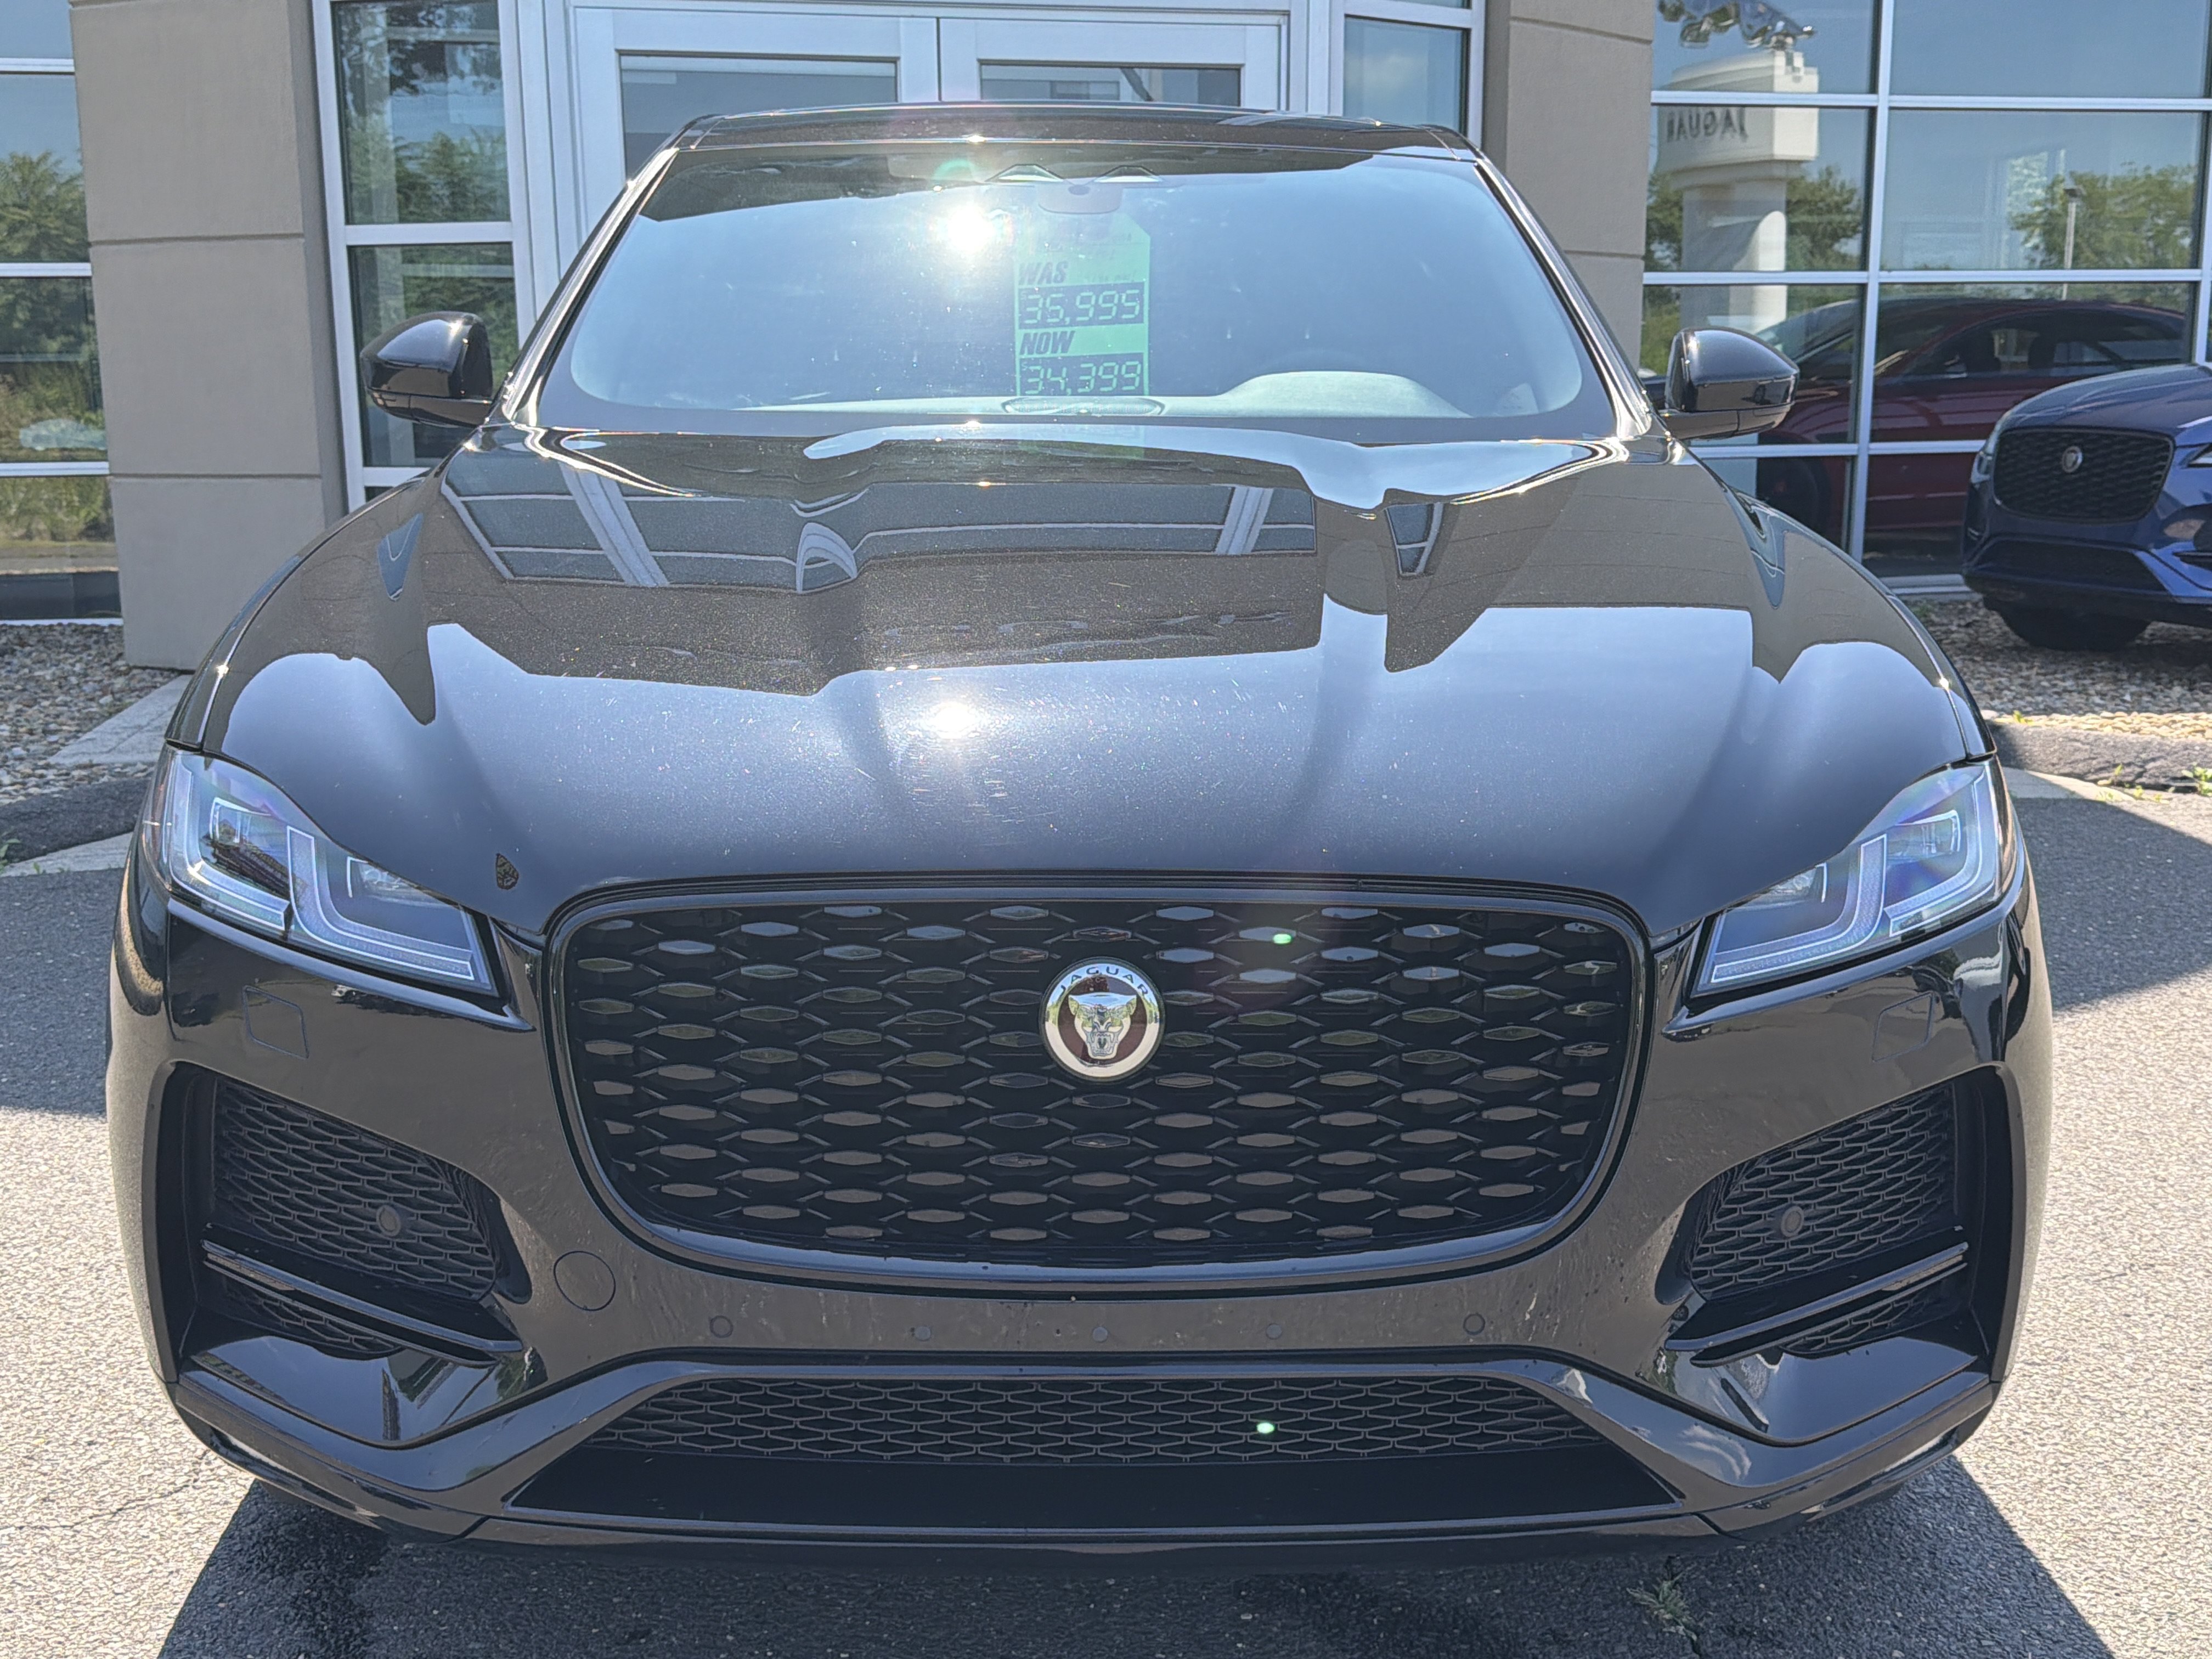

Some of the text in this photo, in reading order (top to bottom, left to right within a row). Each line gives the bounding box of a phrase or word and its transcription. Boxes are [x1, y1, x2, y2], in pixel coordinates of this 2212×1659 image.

[1018, 261, 1069, 285] WAS
[1019, 330, 1075, 355] NOW
[1058, 966, 1148, 996] JAGUAR
